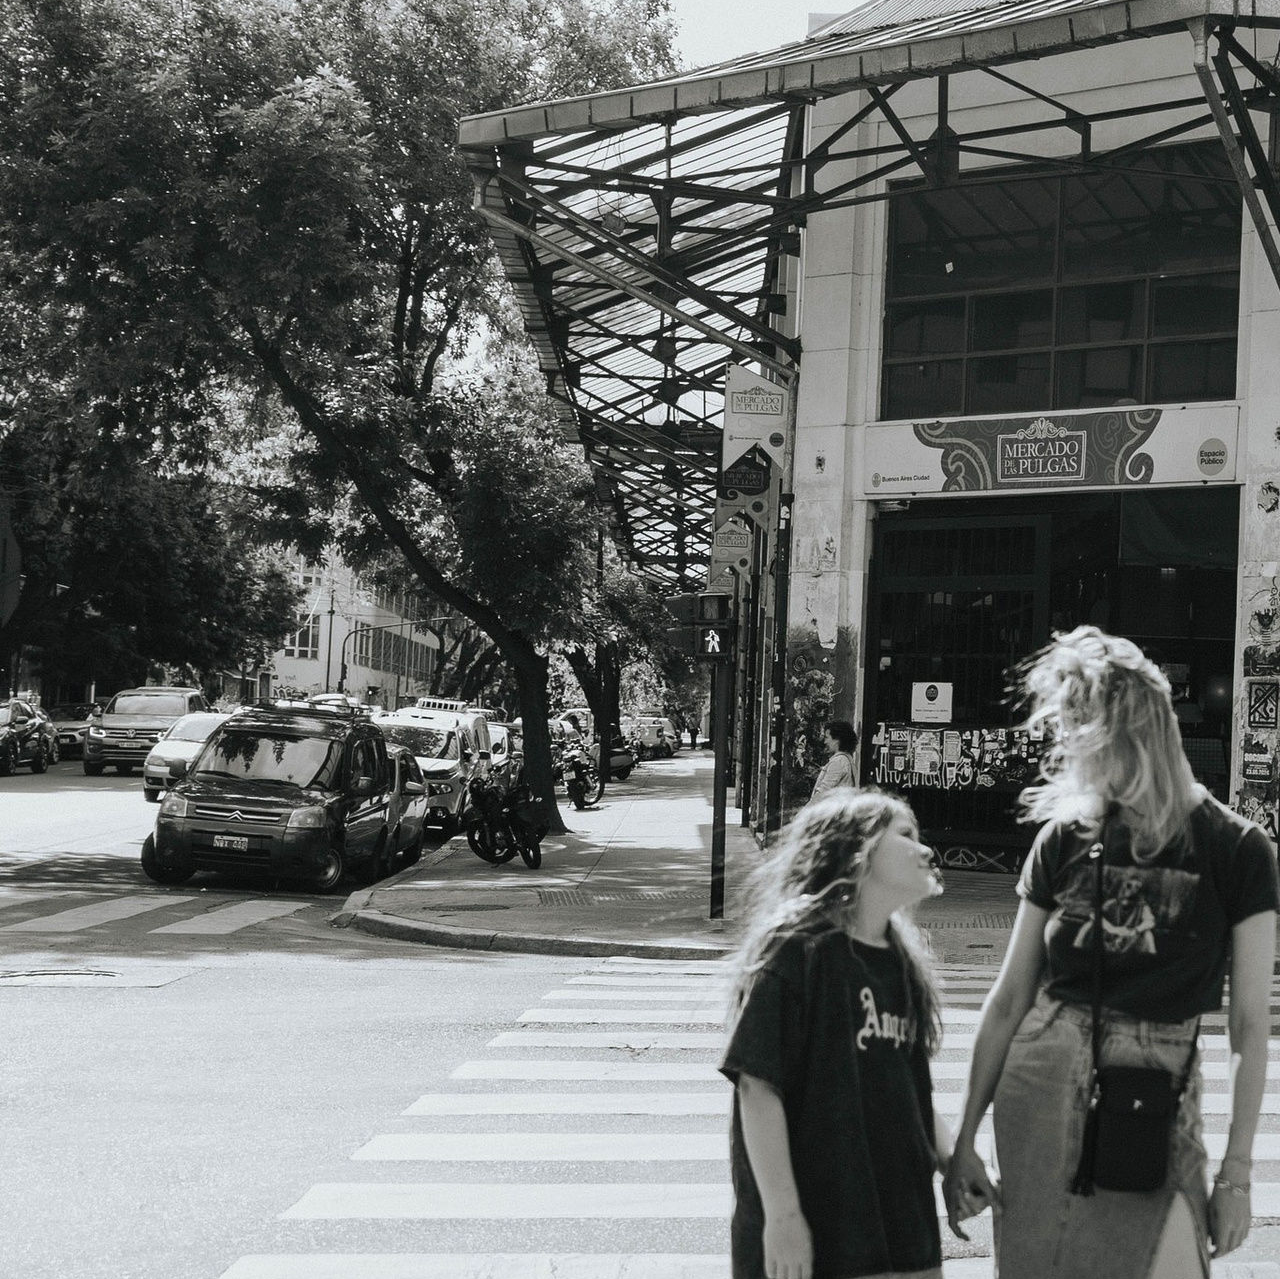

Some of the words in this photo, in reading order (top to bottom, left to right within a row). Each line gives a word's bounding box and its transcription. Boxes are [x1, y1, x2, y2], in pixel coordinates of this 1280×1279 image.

[736, 395, 780, 404] MERCADO
[744, 403, 780, 413] PULGAS
[1004, 440, 1079, 458] MERCADO
[1200, 449, 1226, 459] Espacio
[1004, 459, 1016, 468] DE
[1018, 456, 1078, 475] PULGAS
[1200, 457, 1224, 465] Público
[1004, 467, 1018, 475] LAS
[891, 730, 910, 742] MESS
